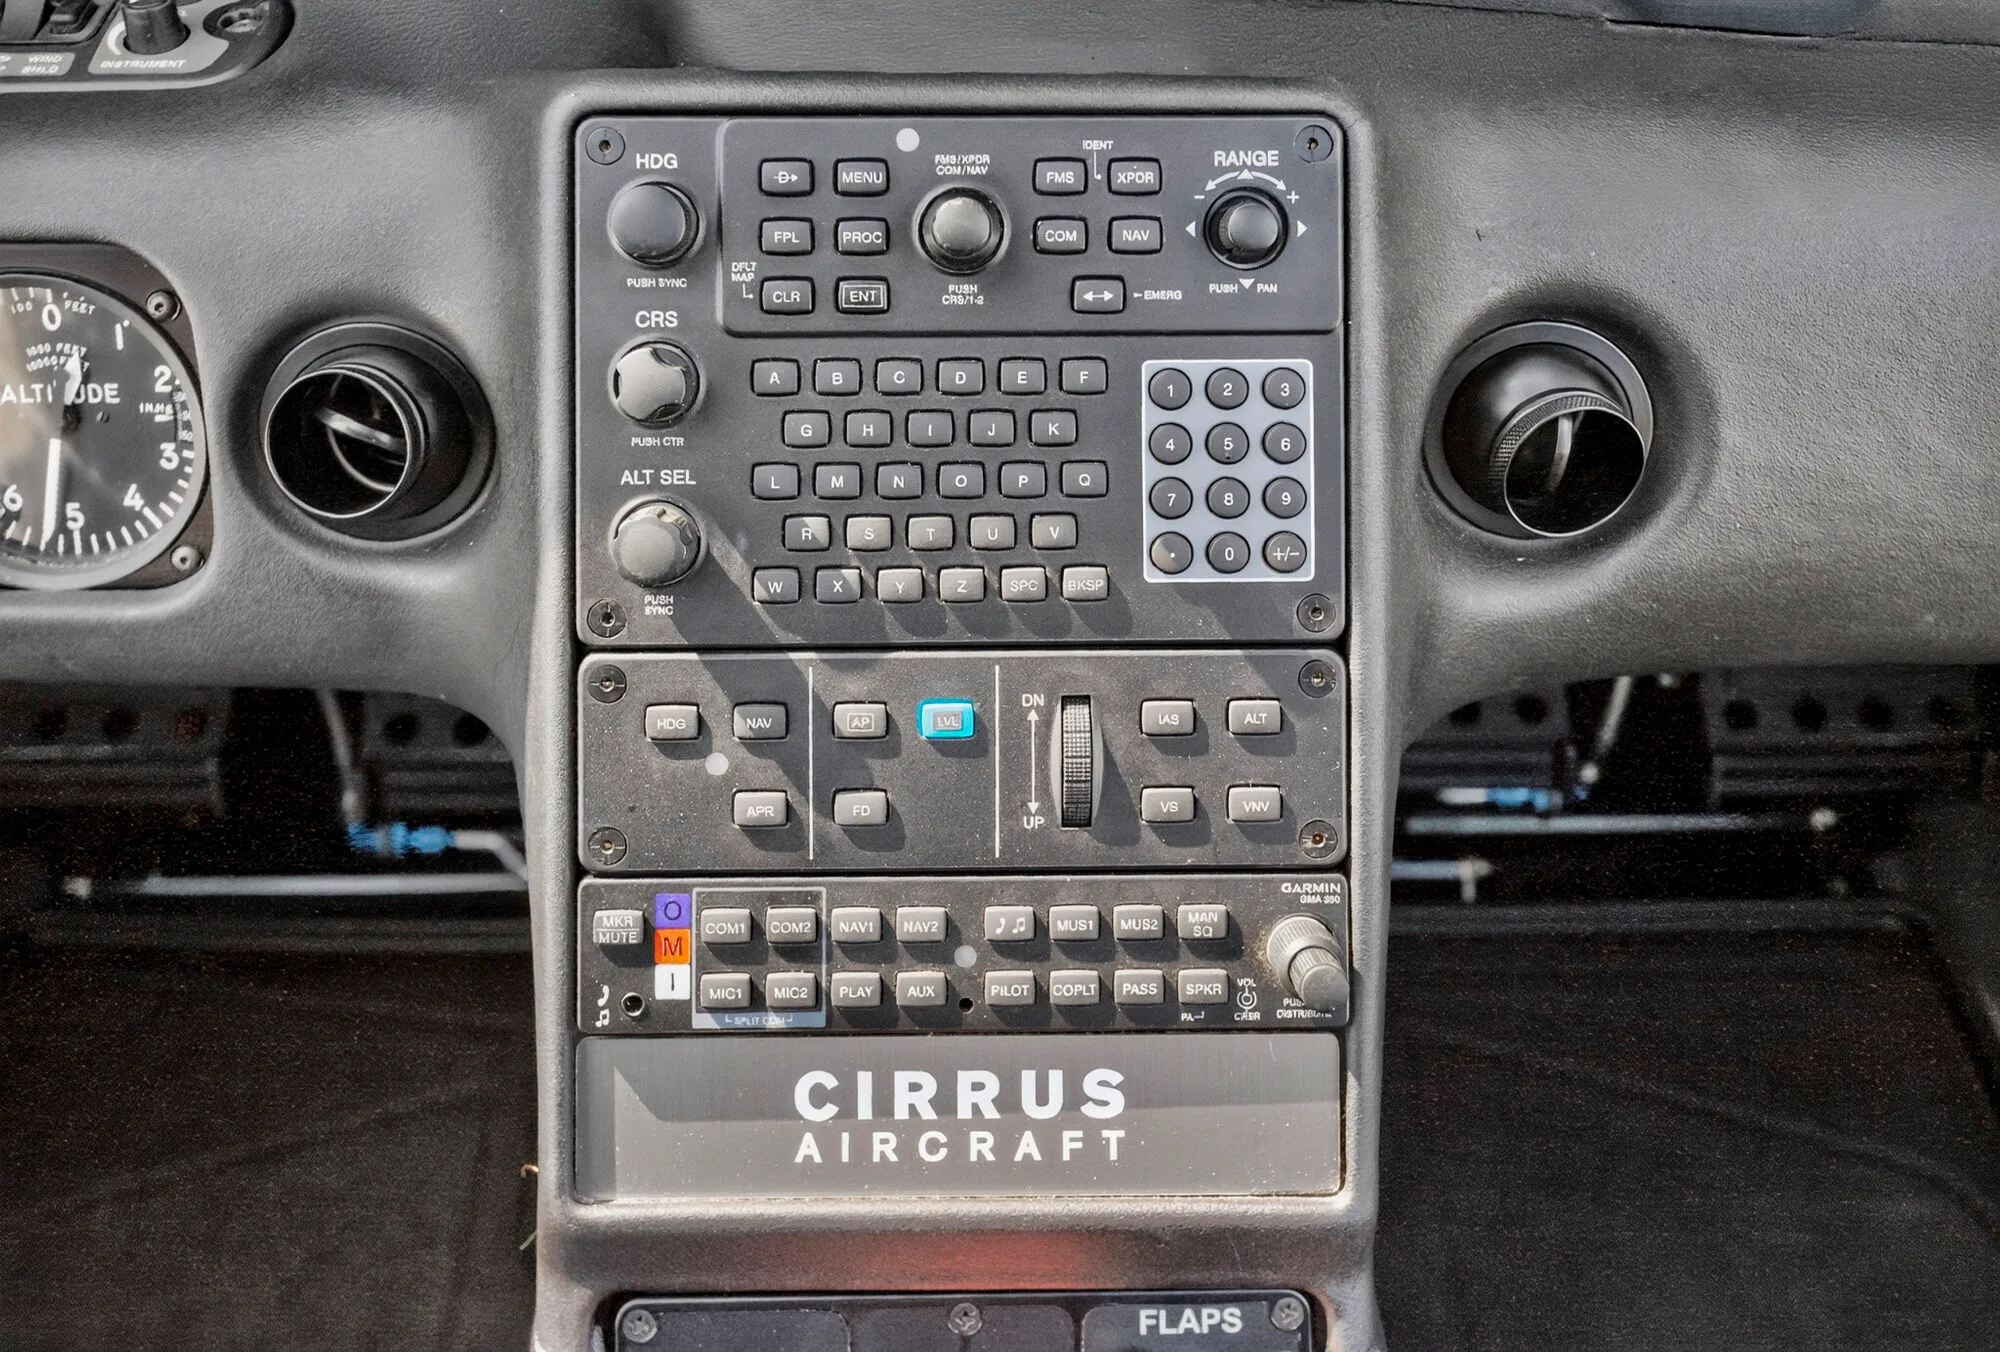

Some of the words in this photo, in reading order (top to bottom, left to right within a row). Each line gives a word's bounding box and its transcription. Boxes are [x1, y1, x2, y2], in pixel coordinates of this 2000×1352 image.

[100, 59, 187, 69] INSTRUMENT
[1082, 140, 1114, 150] IDENT
[635, 152, 679, 170] HDG
[1213, 151, 1280, 167] RANGE
[936, 165, 988, 175] COM/NAV
[842, 171, 883, 184] MENU
[1046, 171, 1075, 184] FMS
[1117, 171, 1154, 184] XPDR
[774, 231, 800, 244] FPL
[842, 231, 883, 244] PROC
[1044, 230, 1077, 242] COM
[1122, 230, 1150, 242] NAV
[731, 261, 757, 272] DFLT
[627, 277, 656, 288] PUSH
[658, 277, 688, 288] SYNC
[731, 272, 755, 282] MAP
[948, 284, 978, 294] PUSH
[1209, 283, 1238, 293] PUSH
[1257, 283, 1278, 293] PAN
[772, 291, 800, 303] CLR
[849, 291, 877, 302] ENT
[1144, 290, 1182, 300] EMERG
[64, 300, 96, 315] FEET
[41, 303, 62, 332] 0
[634, 310, 678, 328] CRS
[114, 323, 124, 351] 1
[56, 342, 88, 358] FEET
[59, 355, 90, 373] FT
[154, 365, 173, 393] 2
[769, 372, 781, 385] A
[831, 372, 844, 385] B
[893, 371, 906, 384] C
[955, 371, 967, 384] D
[1017, 371, 1028, 384] E
[1080, 371, 1089, 384] F
[0, 383, 121, 404] ALTIUDE
[1167, 384, 1174, 397] 1
[1223, 383, 1233, 396] 2
[1280, 383, 1290, 396] 3
[800, 424, 813, 437] G
[862, 424, 874, 437] H
[987, 424, 996, 437] J
[1048, 423, 1060, 436] K
[631, 437, 661, 447] PUSH
[663, 437, 684, 447] CTR
[1165, 438, 1175, 451] 4
[1223, 438, 1234, 450] 5
[1281, 438, 1291, 451] 6
[160, 442, 179, 470] 3
[620, 469, 654, 485] ALT
[660, 469, 696, 485] SEL
[771, 476, 780, 489] L
[831, 475, 844, 488] M
[893, 475, 905, 488] N
[955, 475, 968, 488] O
[1018, 475, 1029, 488] P
[1079, 474, 1091, 486] Q
[3, 484, 23, 512] 6
[124, 483, 145, 511] 4
[1167, 493, 1177, 507] 7
[1224, 492, 1234, 506] 8
[1281, 492, 1291, 505] 9
[65, 502, 85, 531] 5
[801, 527, 812, 540] R
[863, 527, 875, 540] S
[926, 528, 935, 541] T
[987, 528, 998, 541] U
[1049, 527, 1060, 539] V
[1225, 547, 1234, 561] 0
[768, 580, 784, 593] W
[832, 580, 843, 593] X
[895, 581, 905, 594] Y
[957, 580, 967, 593] Z
[1010, 579, 1039, 592] SPC
[1068, 579, 1104, 591] BKSP
[644, 595, 674, 605] PUSH
[644, 605, 674, 616] SYNC
[1022, 694, 1045, 708] DN
[656, 716, 687, 730] HDG
[746, 716, 772, 729] NAV
[851, 717, 870, 729] AP
[936, 716, 960, 728] LVL
[1158, 713, 1180, 726] IAS
[1244, 713, 1269, 725] ALT
[747, 805, 775, 817] APR
[852, 804, 871, 817] FD
[1160, 801, 1178, 813] VS
[1243, 800, 1270, 813] VNV
[1023, 816, 1045, 830] UP
[1281, 882, 1341, 894] GARMIN
[1300, 894, 1322, 904] GMA
[664, 900, 682, 921] O
[1188, 911, 1218, 923] MAN
[602, 915, 634, 928] MKR
[770, 921, 812, 934] COM2
[839, 921, 874, 933] NAV1
[903, 920, 938, 933] NAV2
[1057, 919, 1094, 932] MUS1
[1120, 918, 1158, 930] MUS2
[705, 922, 745, 935] COM1
[1193, 925, 1213, 938] SQ
[599, 931, 637, 944] MUTE
[663, 936, 683, 956] M
[1052, 983, 1097, 996] COPLT
[1122, 983, 1158, 995] PASS
[1185, 983, 1222, 995] SPKR
[1236, 978, 1257, 988] VOL
[709, 987, 742, 1000] MIC1
[774, 986, 808, 999] MIC2
[839, 986, 874, 998] PLAY
[907, 985, 935, 997] AUX
[990, 984, 1030, 997] PILOT
[733, 1016, 760, 1026] SPLIT
[762, 1016, 785, 1026] COM
[1181, 1012, 1194, 1022] PA
[793, 1067, 1126, 1122] CIRRUS
[794, 1129, 1126, 1164] AIRCRAFT
[1138, 1307, 1242, 1336] FLAPS
